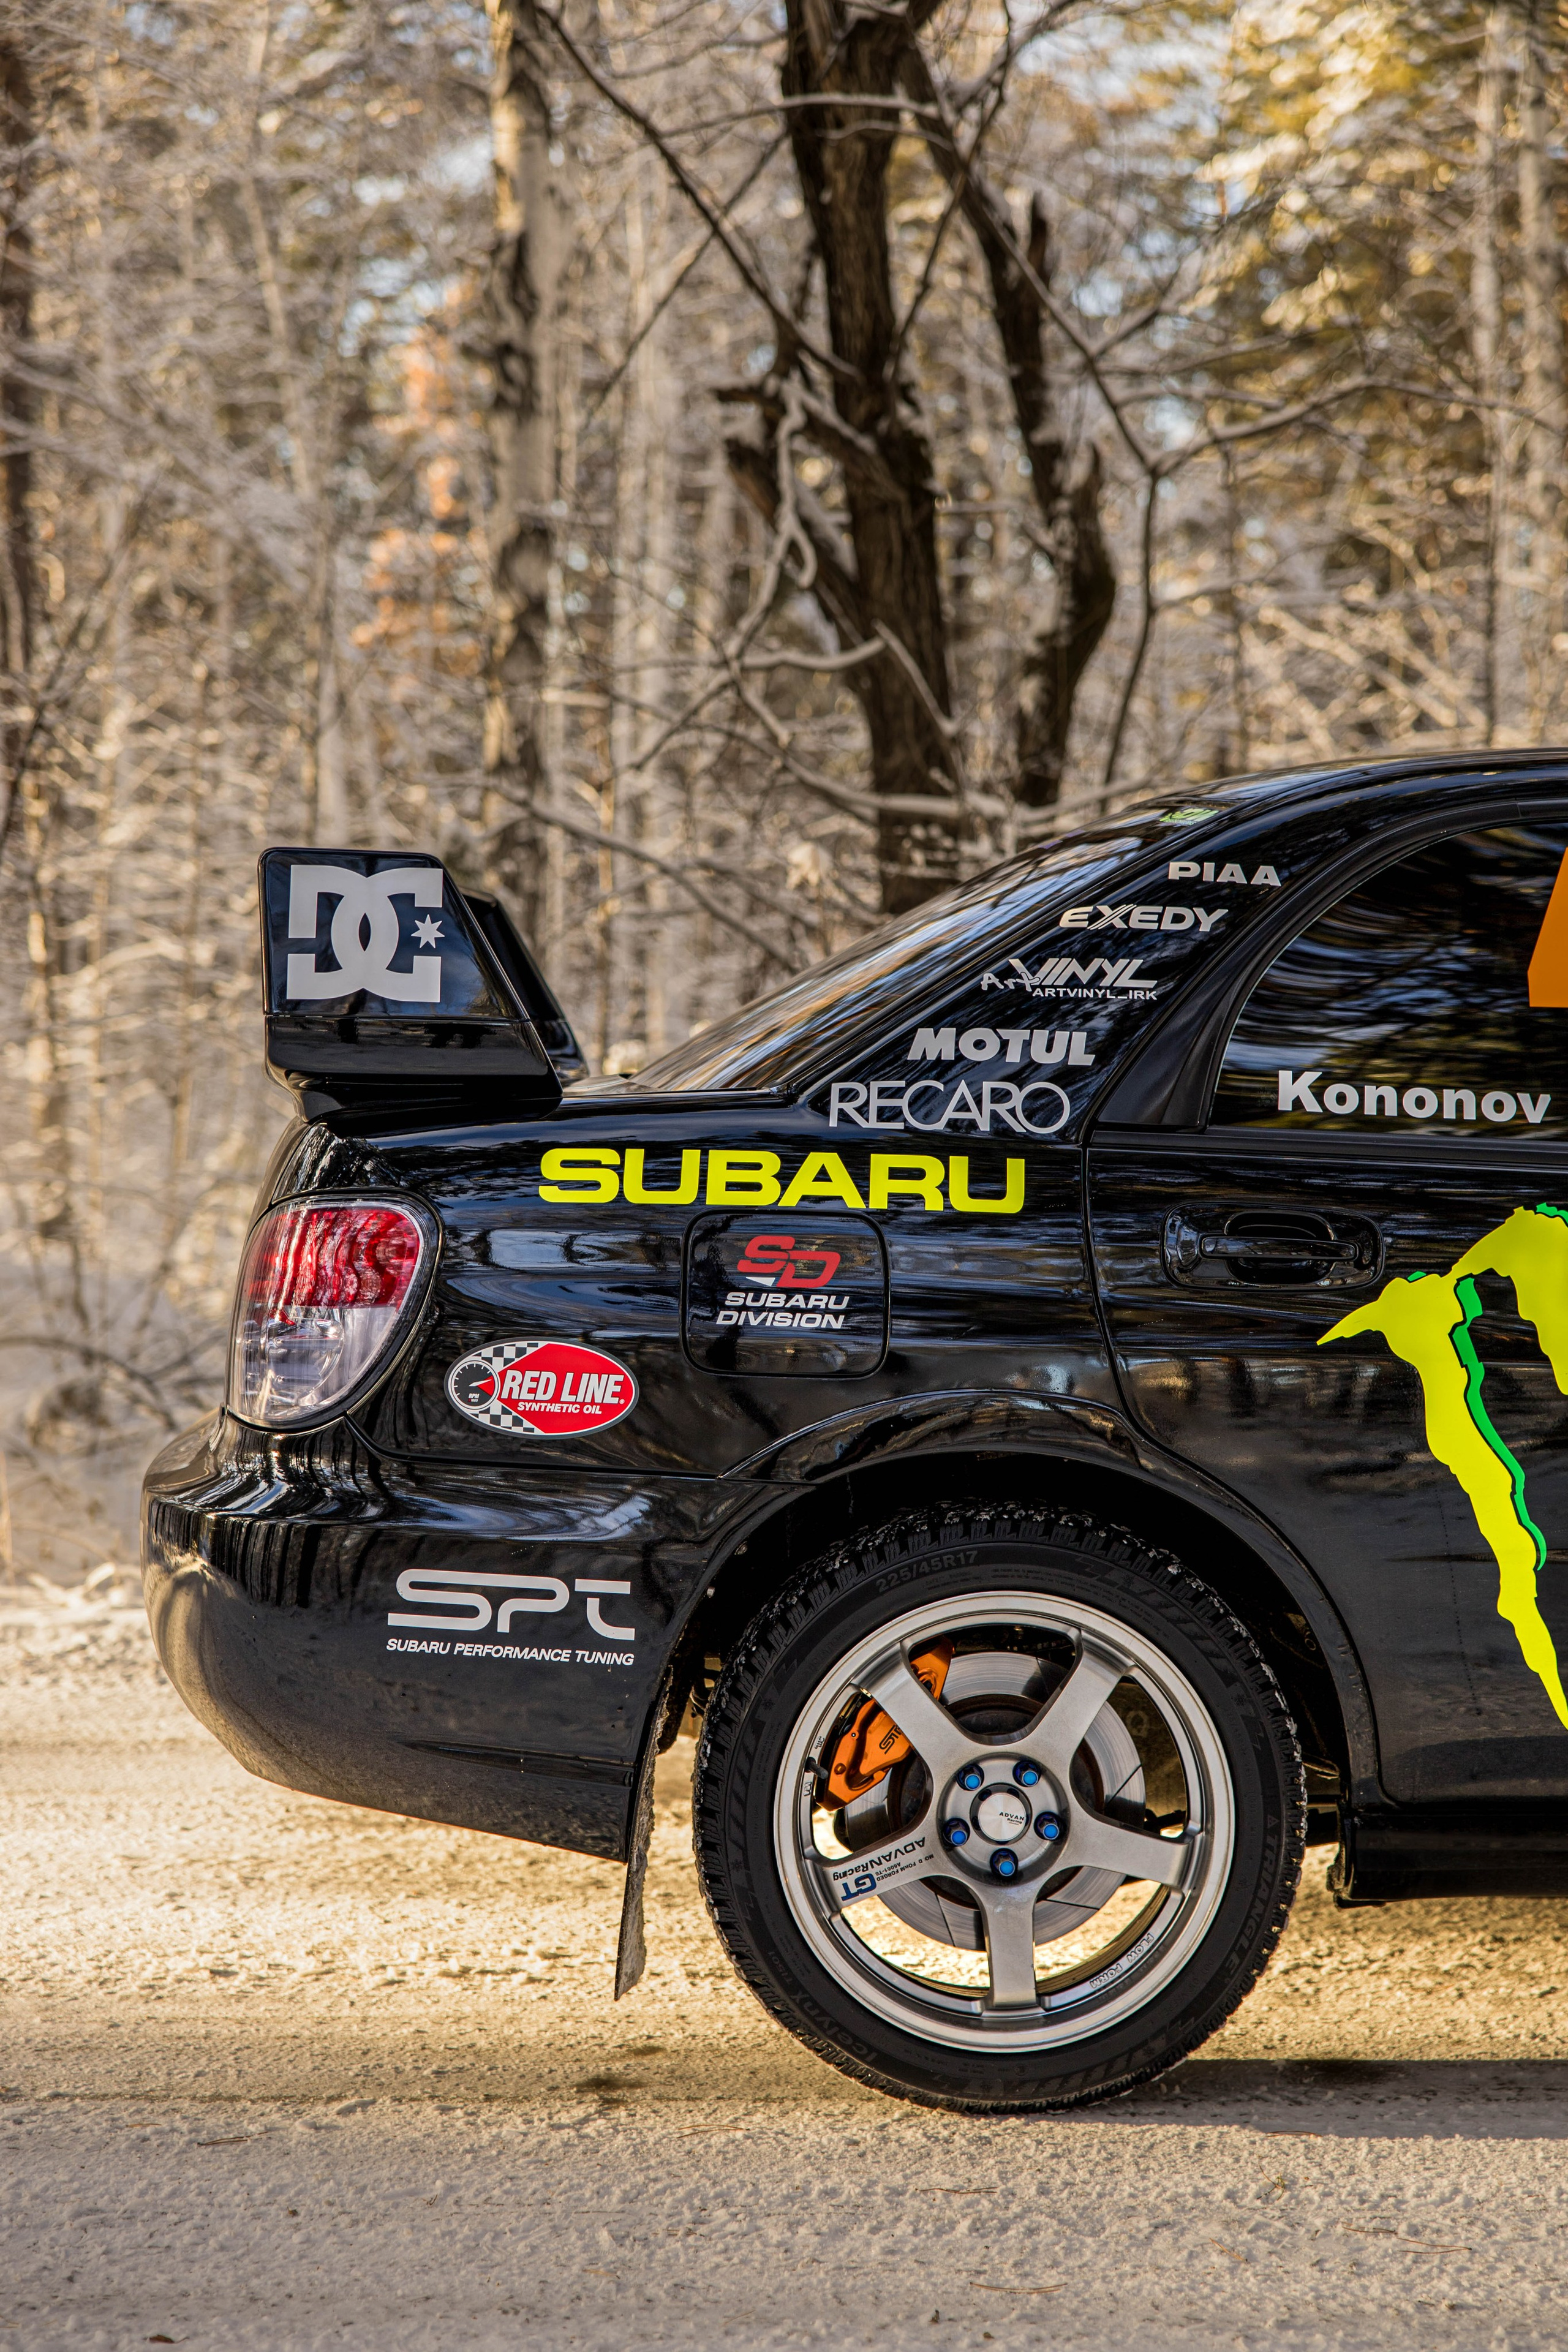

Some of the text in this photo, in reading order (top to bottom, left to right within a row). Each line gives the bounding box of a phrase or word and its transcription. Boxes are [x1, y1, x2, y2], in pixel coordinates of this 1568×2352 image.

[1168, 862, 1281, 887] PIAA
[1059, 903, 1229, 932] EXEDY
[287, 864, 443, 1003] DC
[1032, 988, 1157, 1000] ARTVINYL_IRK
[907, 1028, 1096, 1066] MOTUL
[829, 1079, 1070, 1134] RECARO
[1278, 1070, 1551, 1123] Kononov
[539, 1148, 1025, 1214] SUBARU
[737, 1235, 841, 1289] SD
[725, 1292, 850, 1310] SUBARU
[716, 1311, 845, 1329] DIVISION
[501, 1370, 624, 1404] RED LINE
[517, 1401, 602, 1415] SYNTHETIC OIL
[876, 1550, 978, 1592] 225/45R17
[386, 1638, 635, 1666] SUBARU PERFORMANCE TUNING
[999, 1812, 1025, 1820] ADVAN
[841, 1873, 877, 1901] GT
[876, 1869, 900, 1882] FORGED
[1226, 1834, 1278, 1974] TRIANGLE
[1090, 1932, 1155, 1988] FLOW FORM
